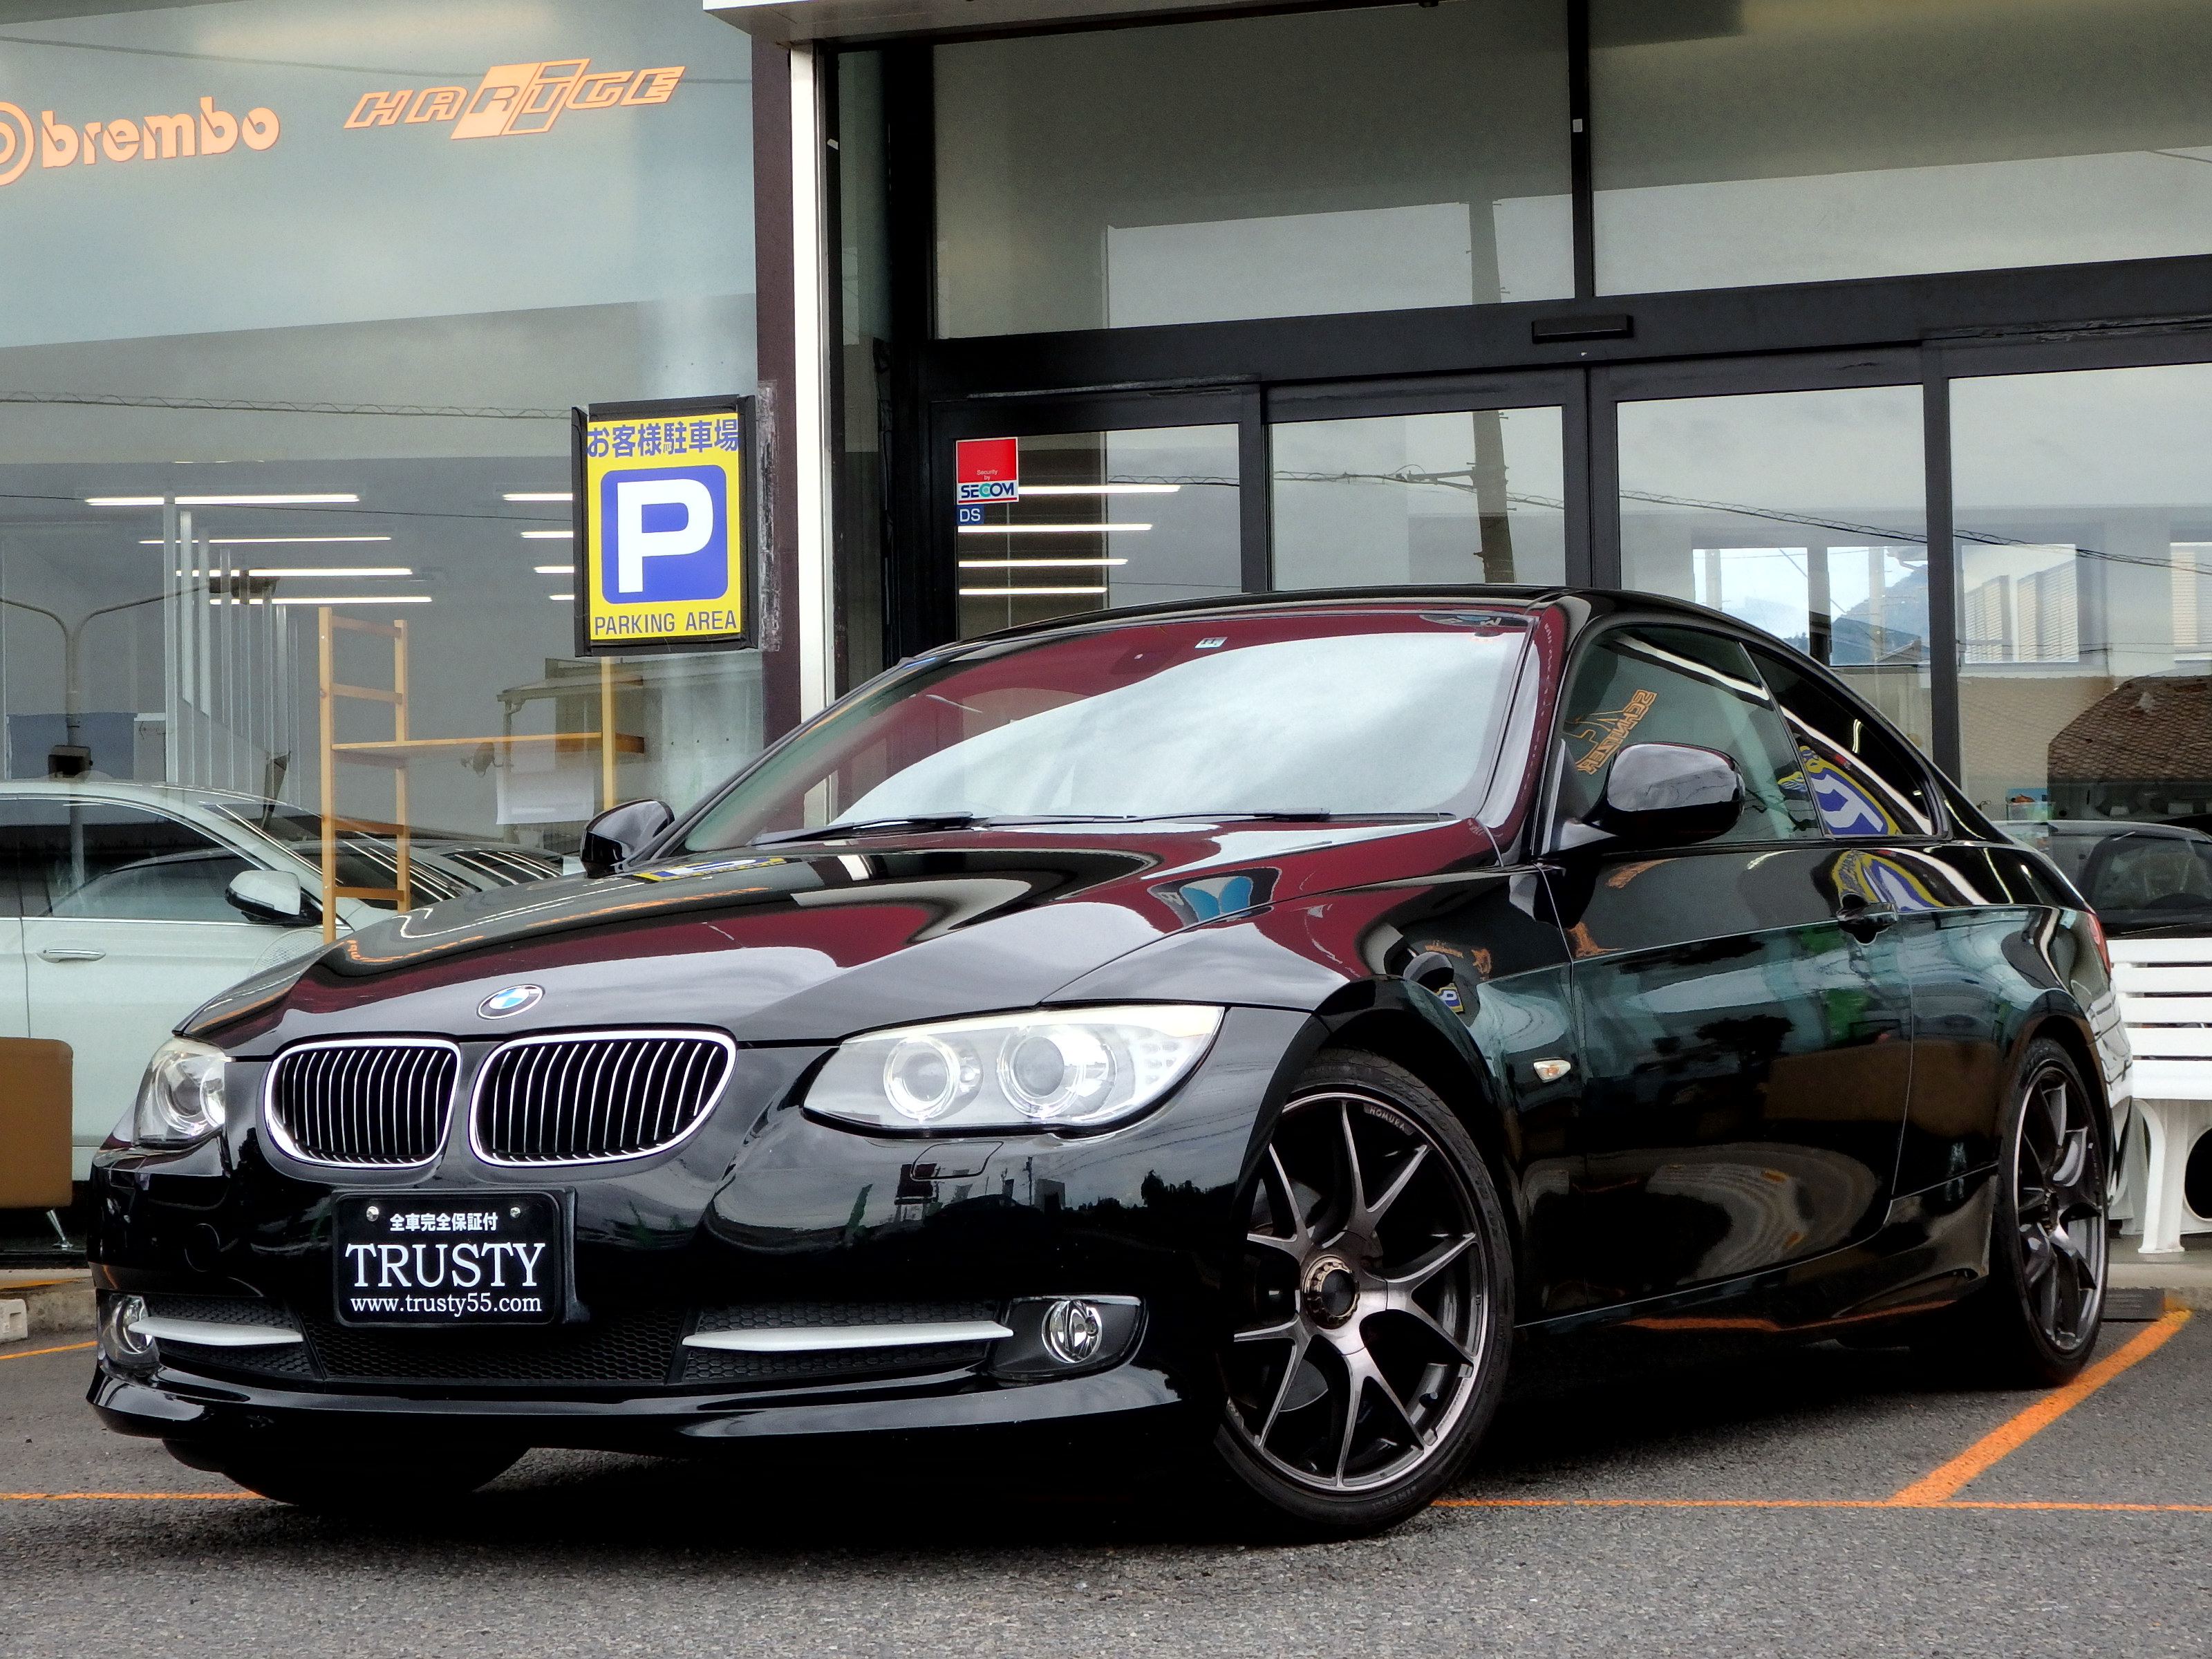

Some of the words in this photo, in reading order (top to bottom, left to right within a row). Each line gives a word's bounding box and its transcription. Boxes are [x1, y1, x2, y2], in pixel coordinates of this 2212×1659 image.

[41, 95, 280, 168] brembo
[587, 419, 738, 458] お客様駐車場
[960, 482, 1014, 498] SECOM
[959, 508, 981, 523] DS
[617, 478, 713, 593] P
[594, 612, 675, 636] PARKING
[685, 610, 737, 631] AREA
[1369, 1107, 1406, 1131] HOMURA
[390, 1212, 498, 1232] 全車完全保証付
[345, 1241, 546, 1288] TRUSTY
[350, 1292, 543, 1318] www.trusty55.com
